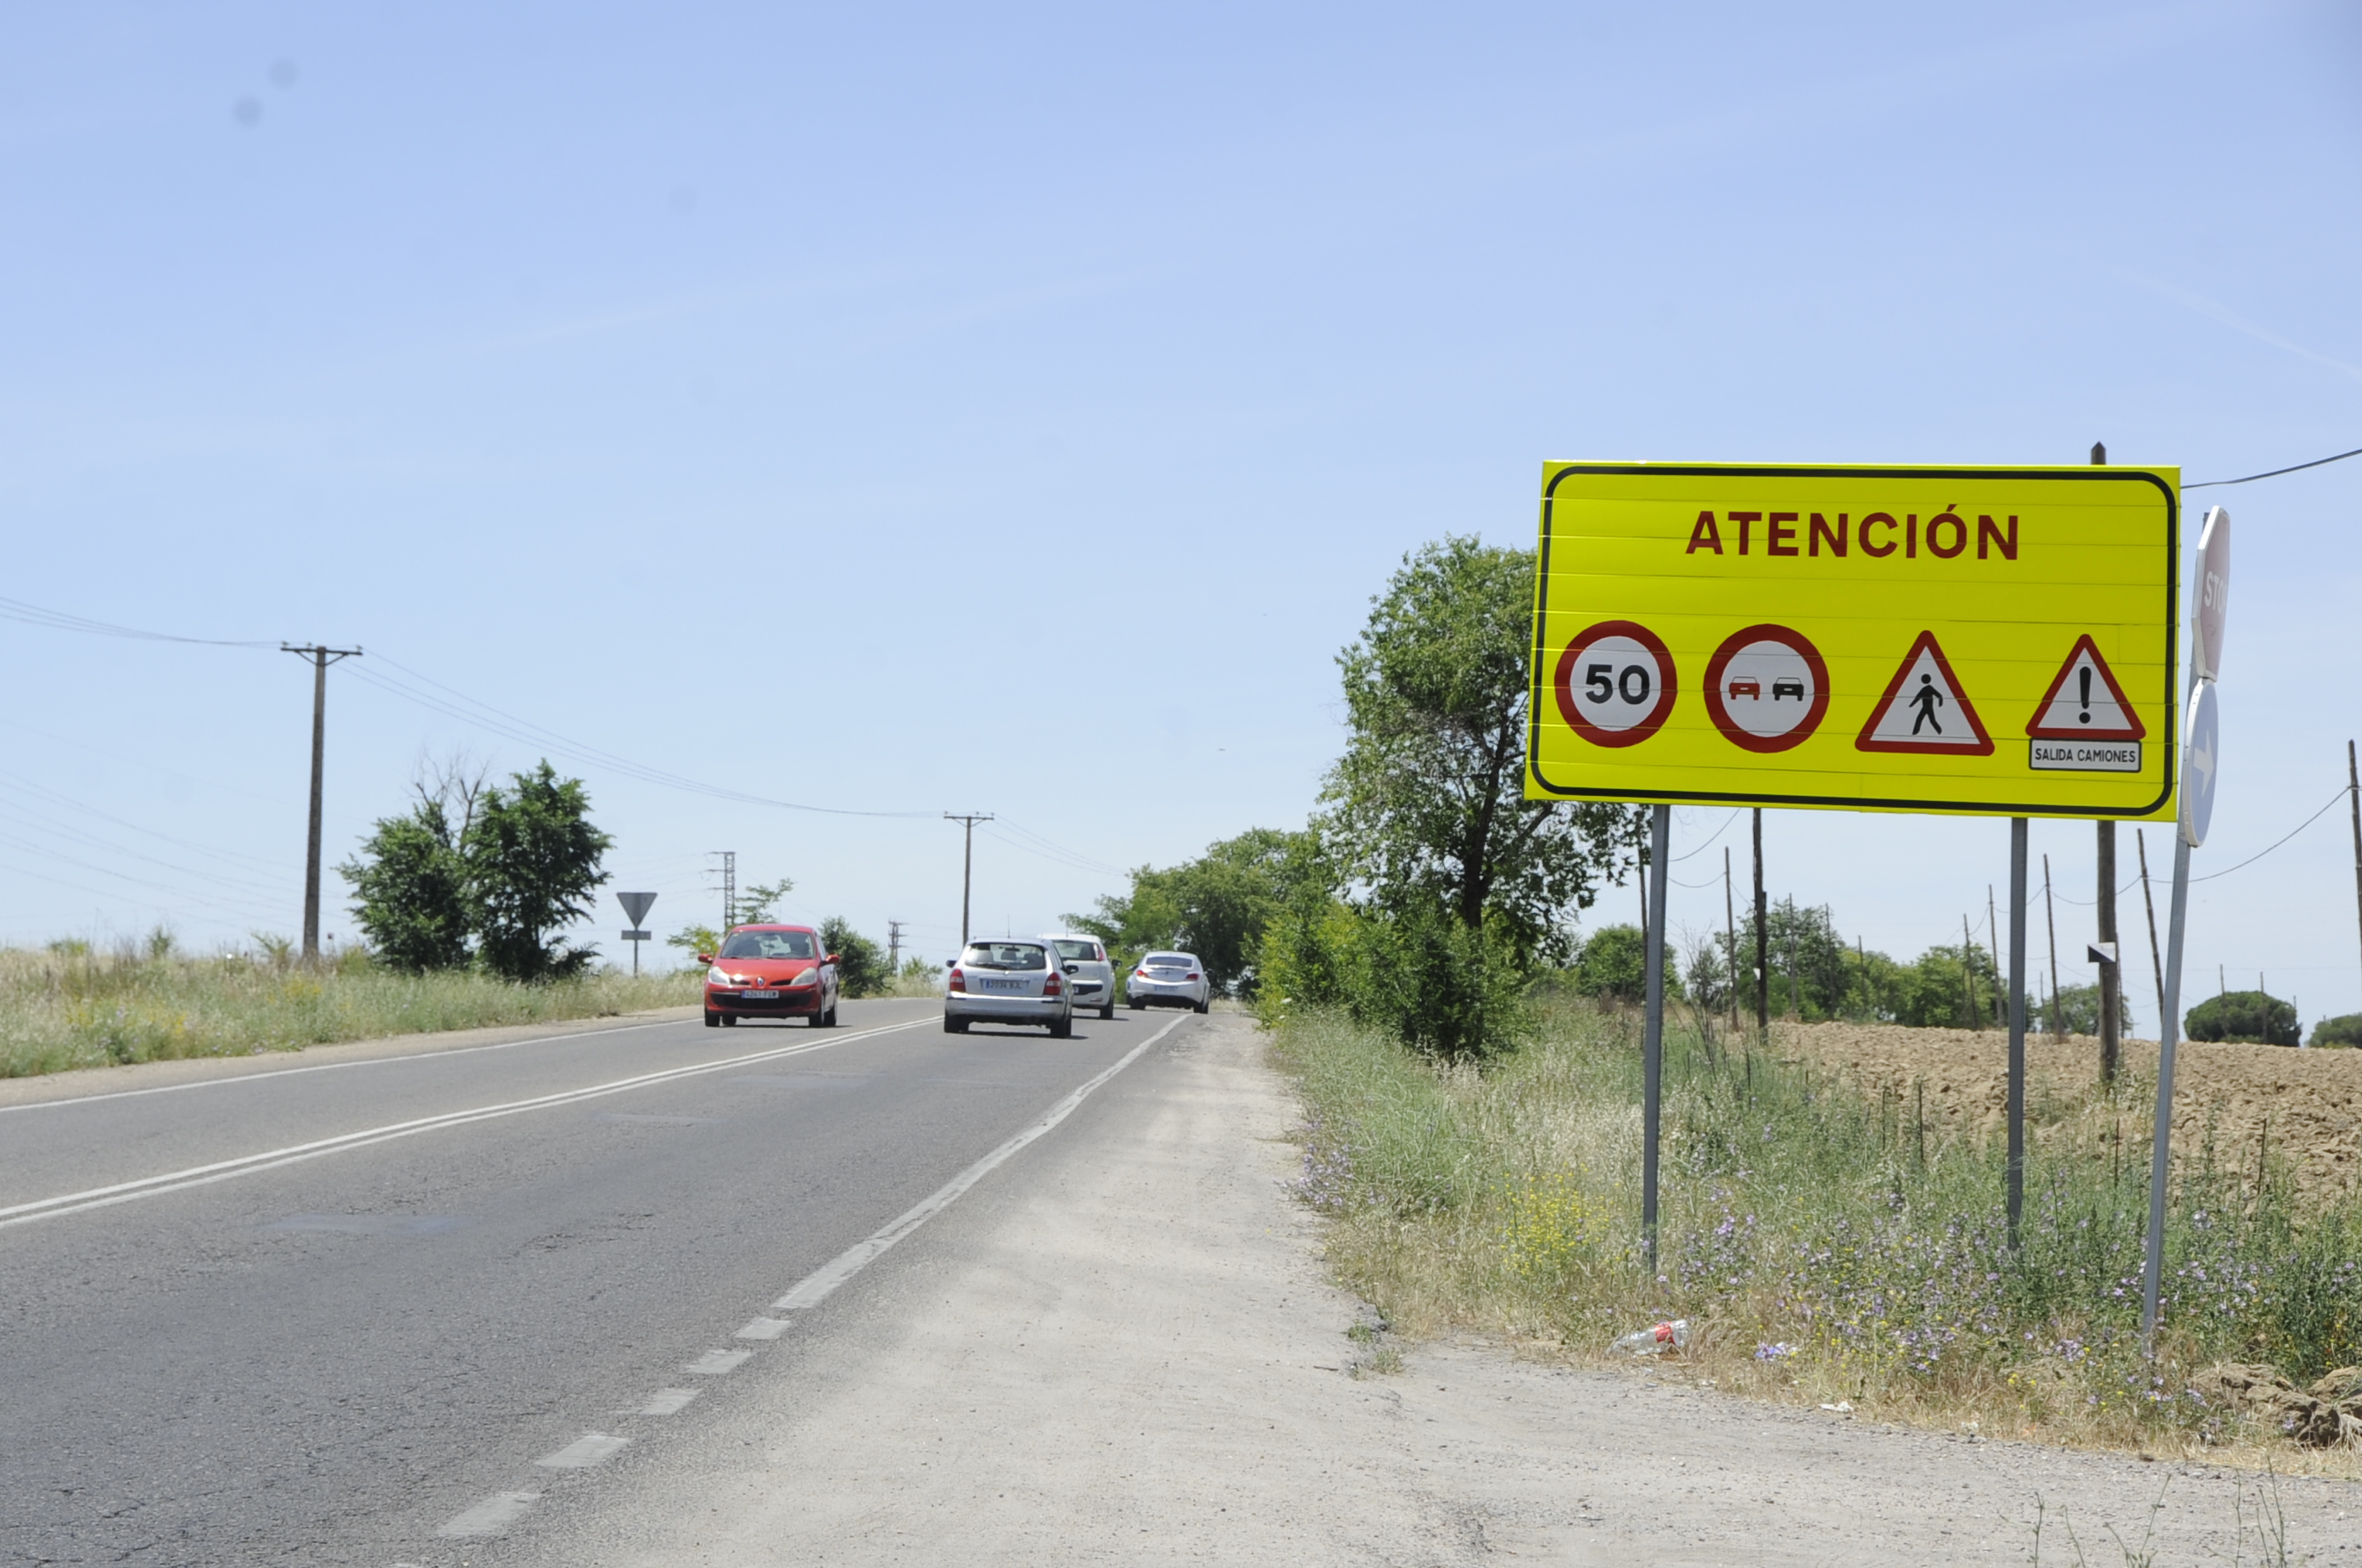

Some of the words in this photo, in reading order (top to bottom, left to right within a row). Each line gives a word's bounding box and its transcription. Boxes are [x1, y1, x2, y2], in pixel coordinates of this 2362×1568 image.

[1685, 504, 2018, 560] ATENCIÓN
[2204, 570, 2227, 615] STO
[1586, 664, 1650, 705] 50
[2035, 748, 2074, 762] SALIDA
[2077, 748, 2136, 763] CAMIONES
